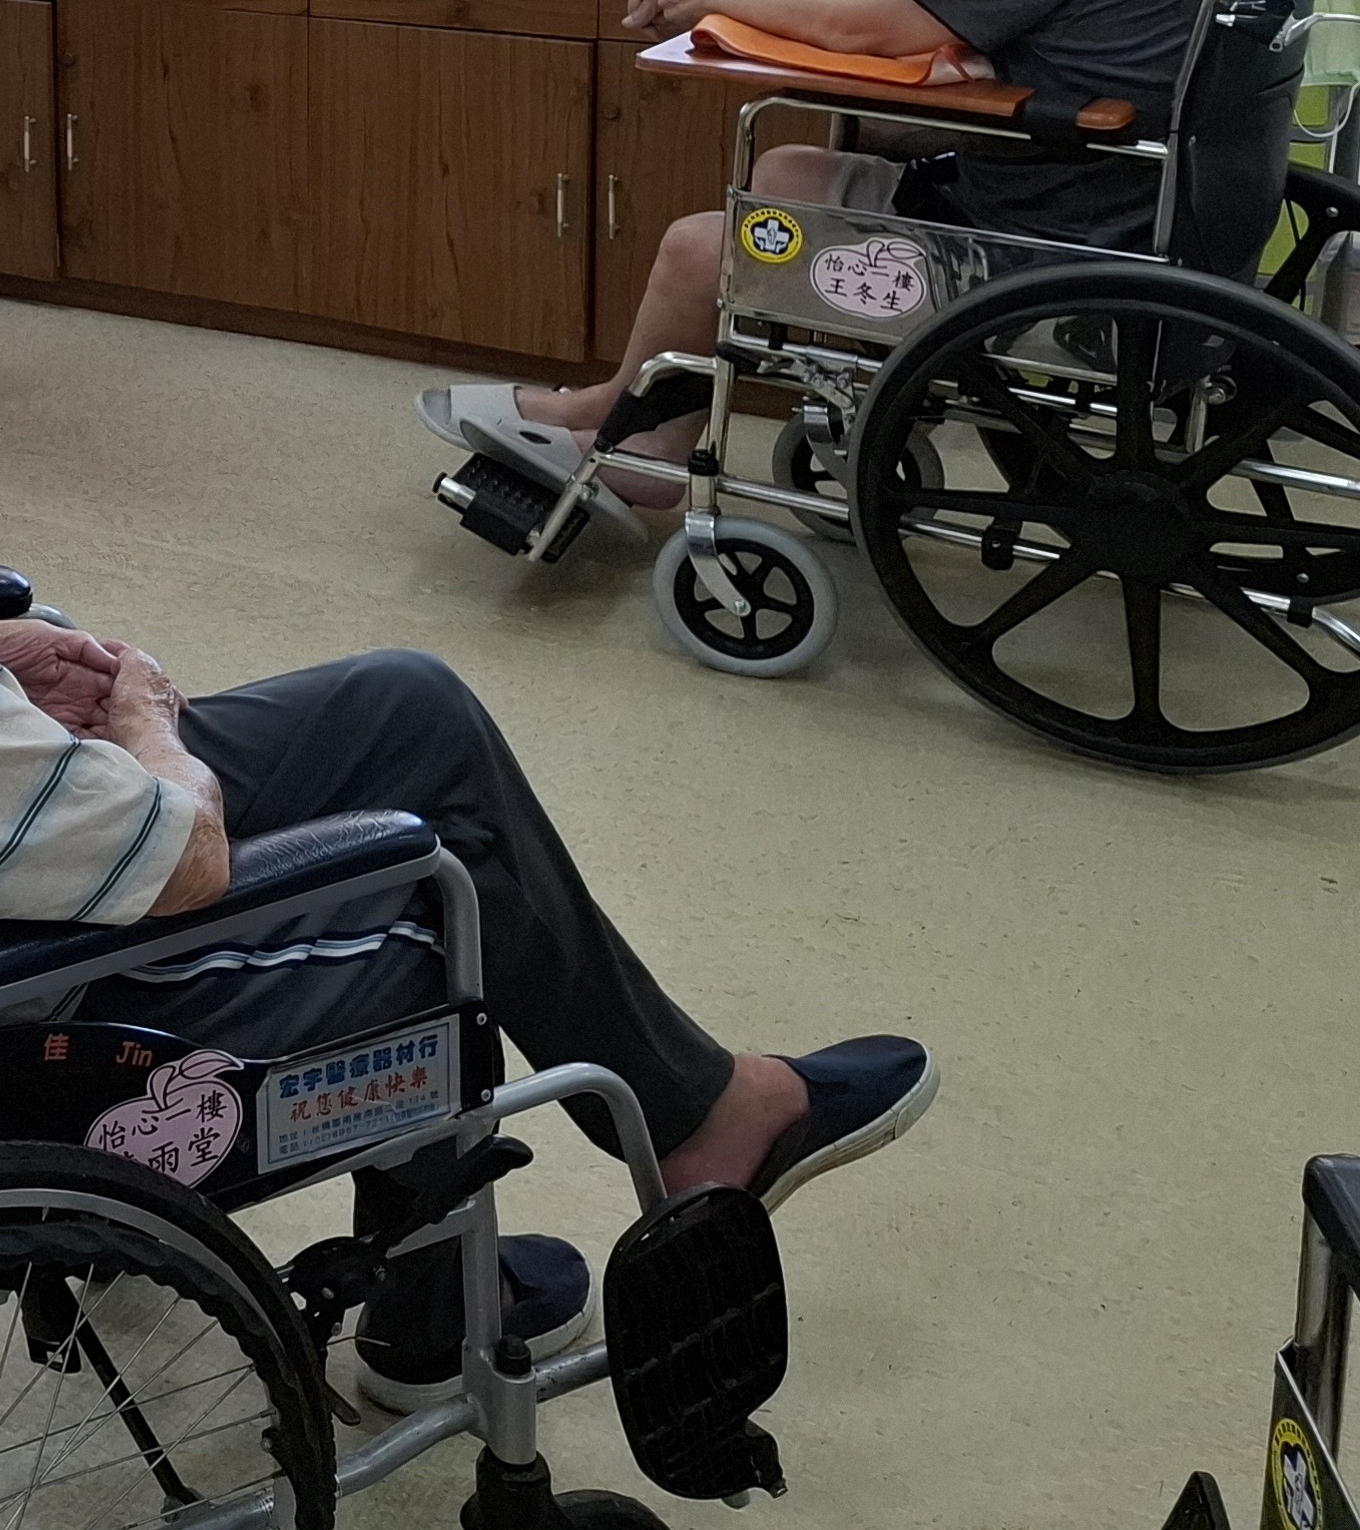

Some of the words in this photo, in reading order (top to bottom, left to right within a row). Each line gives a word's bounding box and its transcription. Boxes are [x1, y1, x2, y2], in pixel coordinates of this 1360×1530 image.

[824, 255, 917, 292] 怡心一樓
[824, 277, 904, 313] 王冬生
[115, 1040, 153, 1067] Jin
[279, 1033, 439, 1099] 宏宇醫療器材行
[290, 1065, 429, 1122] 祝您健康快樂
[98, 1089, 228, 1151] 怡心一樓
[123, 1126, 221, 1173] 雨堂
